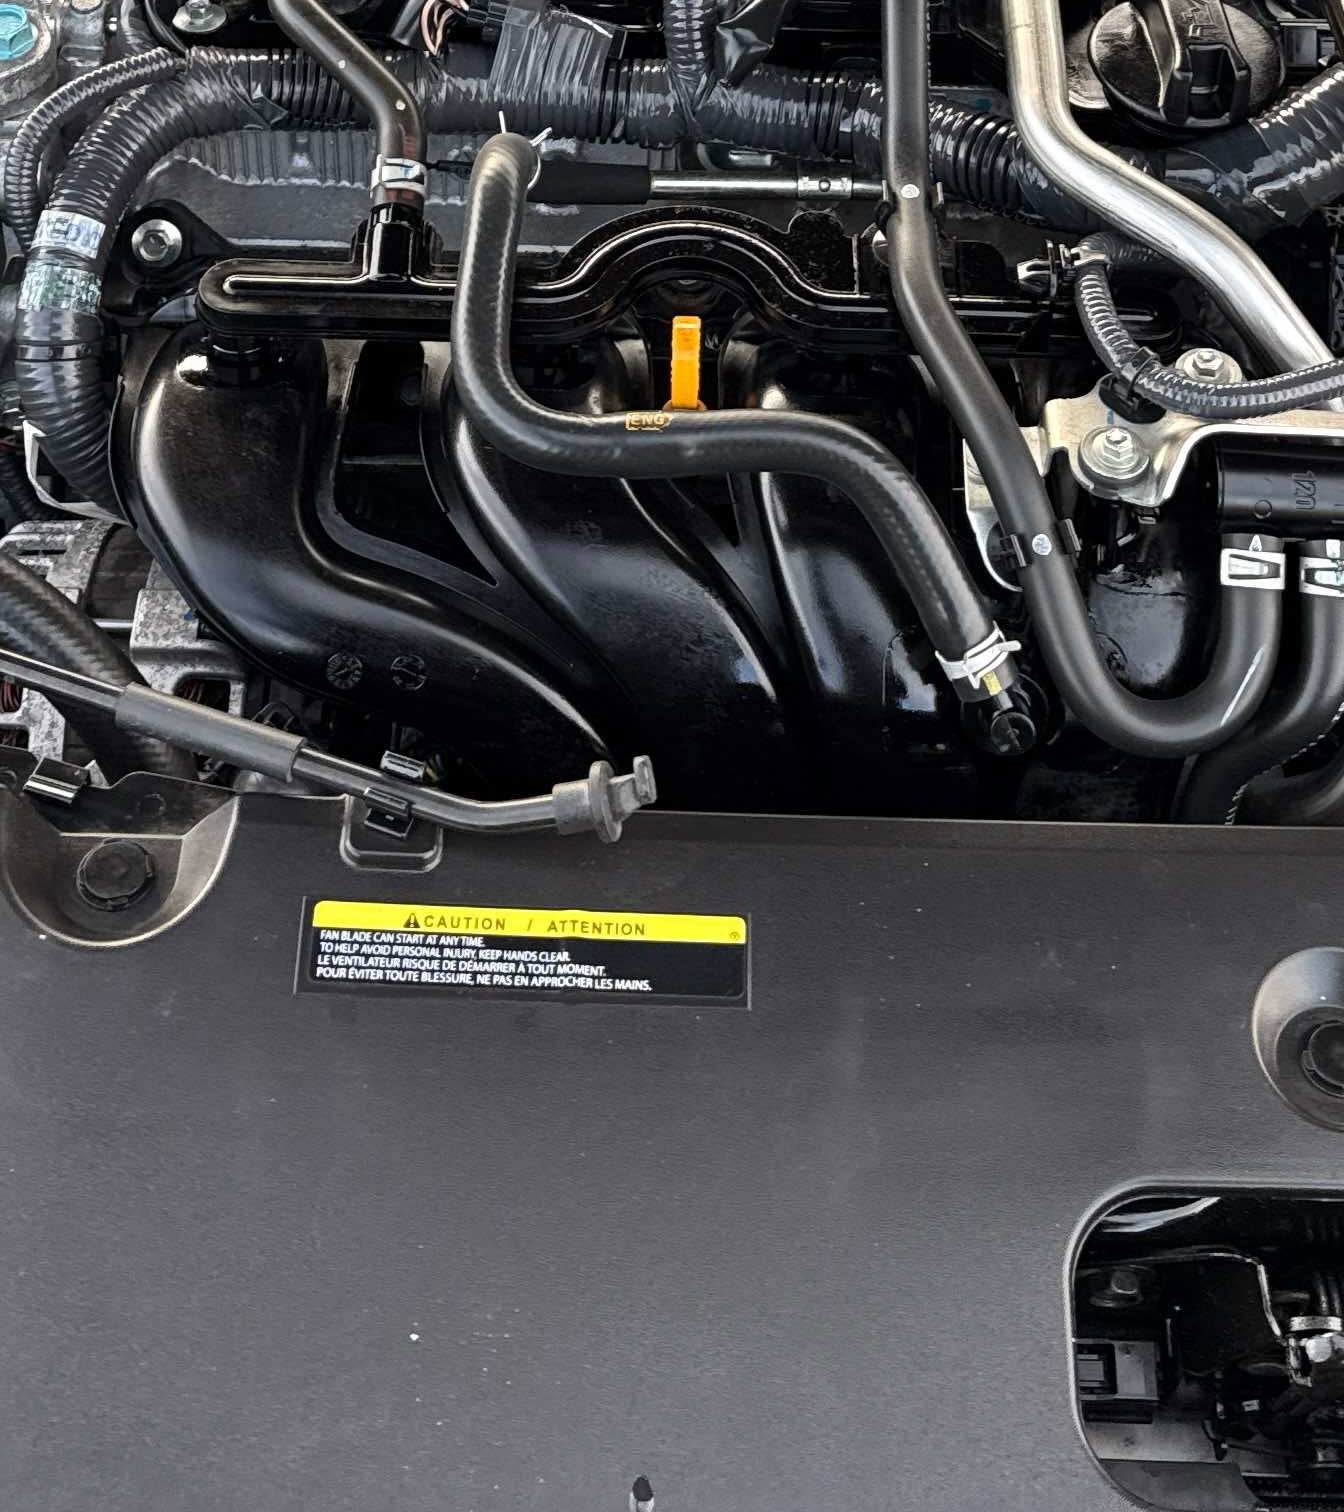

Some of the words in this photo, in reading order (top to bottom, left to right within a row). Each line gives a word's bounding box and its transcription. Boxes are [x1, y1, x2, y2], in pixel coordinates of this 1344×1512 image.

[630, 413, 666, 426] ENG
[424, 915, 506, 930] CAUTION
[547, 920, 646, 936] ATTENTION
[320, 930, 340, 940] FAN
[341, 931, 372, 942] BLADE
[373, 933, 394, 944] CAN
[396, 934, 424, 945] START
[425, 935, 439, 945] AT
[439, 936, 457, 946] ANY
[458, 937, 486, 948] TIME.
[320, 942, 333, 952] TO
[335, 943, 358, 954] HELP
[360, 944, 390, 955] AVOID
[392, 945, 441, 957] PERSONAL
[479, 949, 502, 960] KEEP
[504, 950, 537, 962] HANDS
[317, 954, 331, 965] LE
[331, 955, 400, 968] VENTILATEUR
[403, 959, 440, 971] RISQUE
[442, 959, 456, 971] DE
[459, 958, 515, 973] DÉMARRER
[517, 961, 528, 973] À
[528, 964, 555, 974] TOUT
[557, 965, 606, 976] MOMENT.
[316, 967, 347, 979] POUR
[349, 966, 383, 981] ÉVITER
[385, 970, 419, 982] TOUTE
[421, 972, 475, 986] BLESSURE,
[477, 974, 491, 985] NE
[493, 975, 512, 986] PAS
[514, 976, 529, 986] EN
[530, 977, 592, 989] APPROCHER
[595, 978, 613, 989] LES
[614, 979, 653, 991] MAINS.
